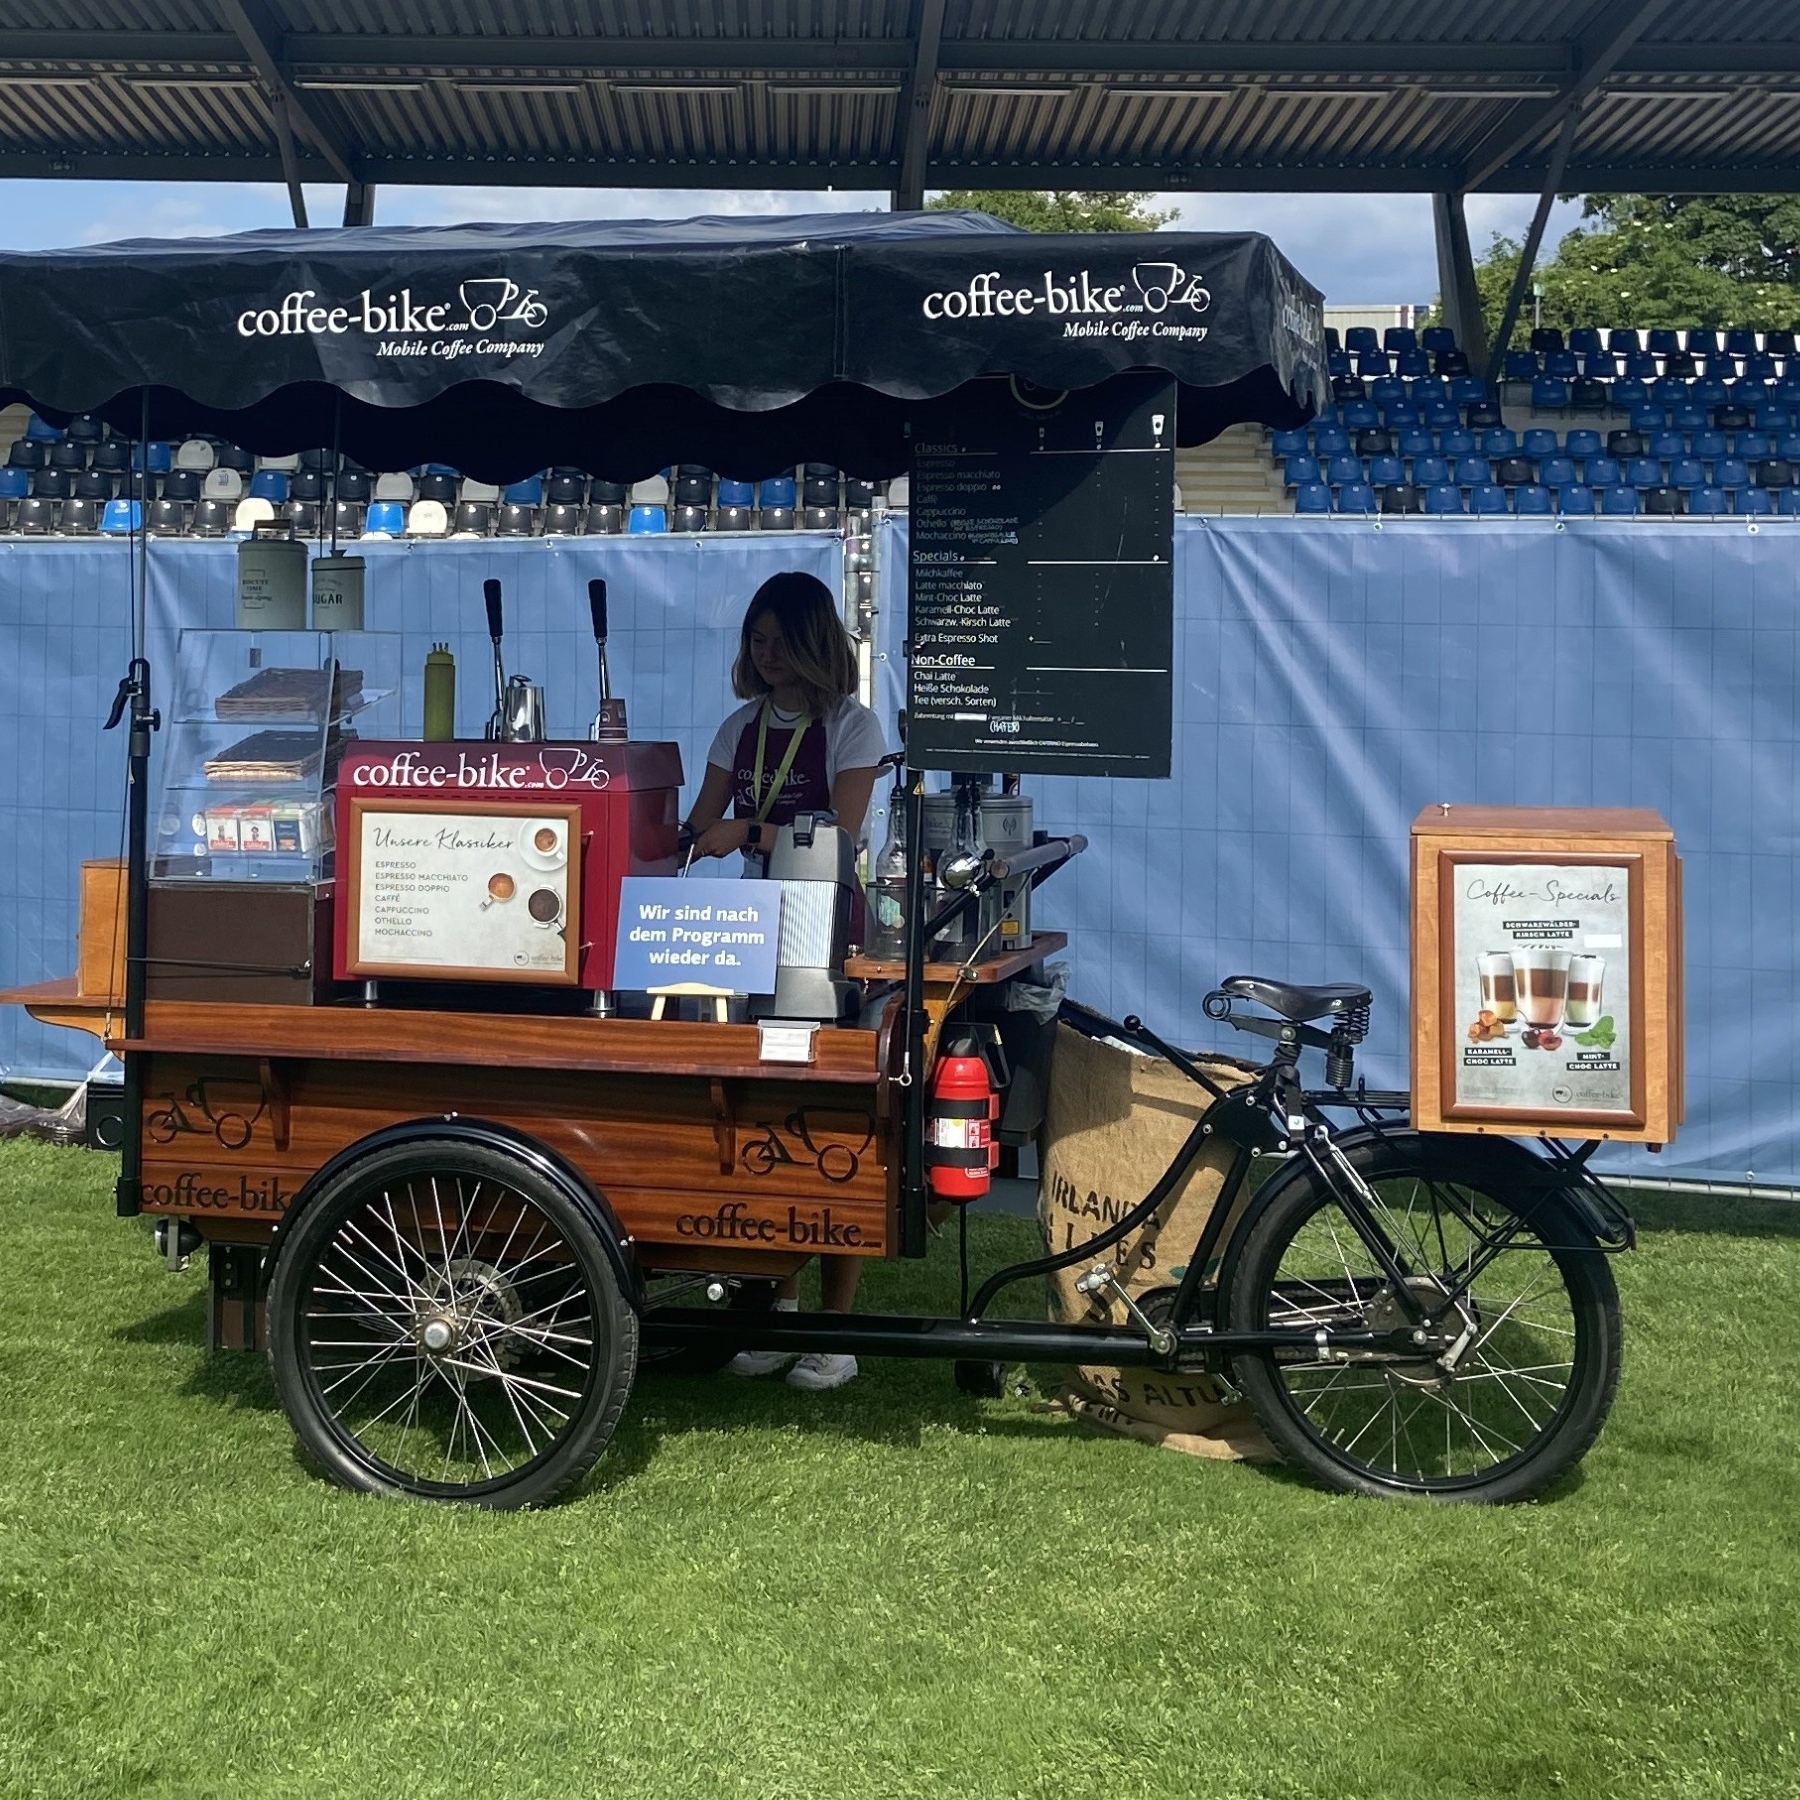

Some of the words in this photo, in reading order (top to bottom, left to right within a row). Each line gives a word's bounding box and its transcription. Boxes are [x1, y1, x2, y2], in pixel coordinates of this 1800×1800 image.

[1062, 321, 1109, 338] Mobile
[1111, 321, 1150, 342] Coffee
[1152, 322, 1208, 342] Company
[376, 340, 427, 357] Mobile
[431, 339, 473, 360] Coffee
[476, 339, 545, 358] Company
[915, 443, 957, 453] Classics
[916, 471, 955, 481] Espresso
[957, 470, 1000, 479] macchiato
[917, 483, 955, 493] Espresso
[957, 482, 987, 492] doppio
[916, 507, 966, 517] Cappuccino
[916, 531, 967, 540] Mochaccino
[913, 551, 958, 562] Specials
[915, 569, 963, 578] Milchkaffee
[915, 581, 937, 590] Latte
[938, 581, 982, 590] macchiato
[960, 593, 982, 602] Latte
[915, 605, 976, 614] Karamell-Choc
[977, 605, 1000, 614] Latte
[988, 618, 1011, 627] Latte
[914, 634, 936, 643] Extra
[938, 634, 977, 645] Espresso
[978, 634, 999, 643] Shot
[911, 654, 975, 666] Non-Coffee
[914, 672, 933, 681] Chai
[934, 672, 956, 681] Latte
[914, 684, 938, 693] Heiße
[940, 684, 989, 694] Schokolade
[914, 696, 929, 705] Tee
[930, 696, 963, 707] (versch.
[965, 696, 997, 707] Sorten)
[374, 826, 431, 848] Unsere
[434, 827, 514, 850] Klassiker
[375, 861, 417, 869] ESPRESSO
[375, 872, 416, 880] ESPRESSO
[418, 873, 469, 882] MACCHIATO
[375, 883, 416, 892] ESPRESSO
[418, 884, 450, 893] DOPPIO
[374, 905, 430, 915] CAPPUCCINO
[639, 904, 670, 920] Wir
[674, 905, 711, 921] sind
[716, 907, 759, 923] nach
[374, 916, 413, 926] OTHELLO
[374, 928, 433, 937] MOCHACCINO
[629, 926, 666, 942] dem
[672, 927, 765, 946] Programm
[649, 948, 710, 965] wieder
[714, 950, 742, 966] da.
